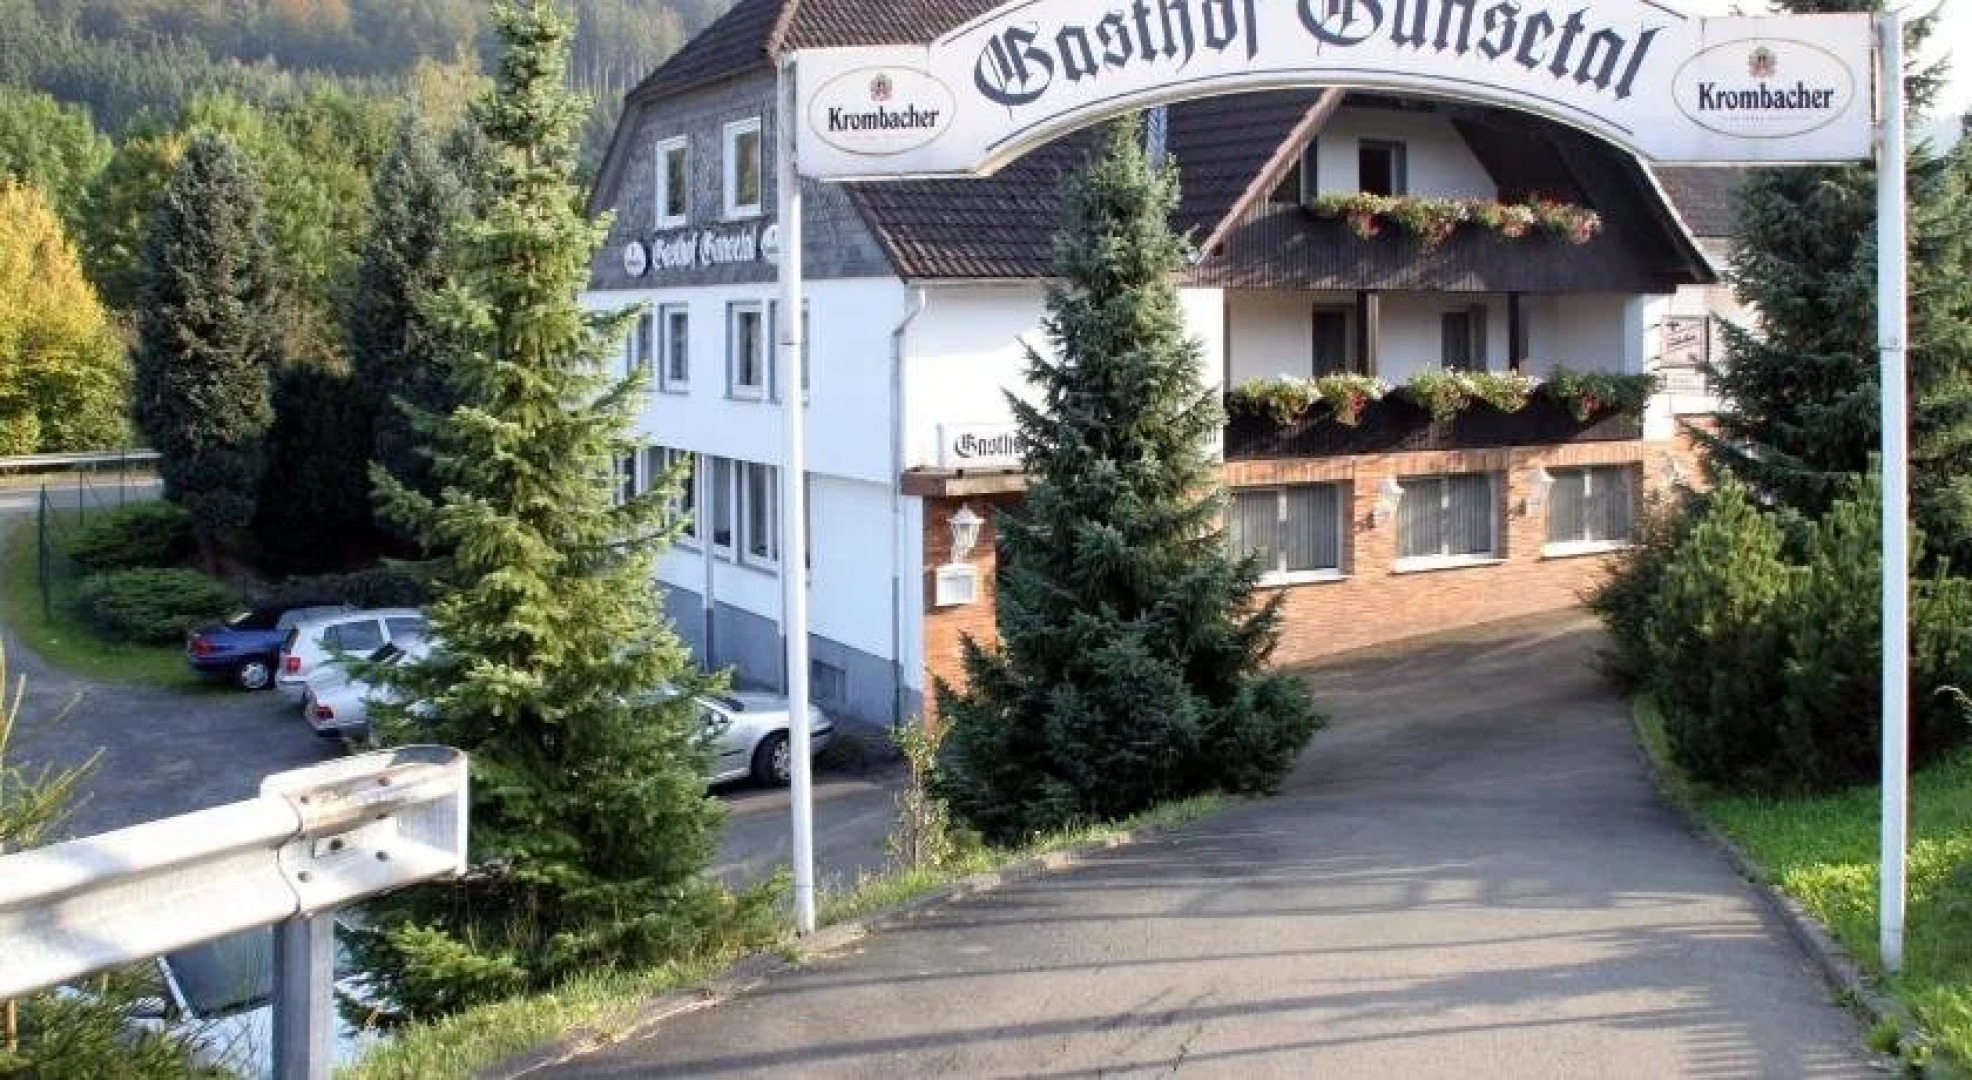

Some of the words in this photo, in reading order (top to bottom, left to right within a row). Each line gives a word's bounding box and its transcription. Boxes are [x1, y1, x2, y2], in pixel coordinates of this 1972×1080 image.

[974, 0, 1260, 118] Gasthof
[1698, 80, 1835, 110] Krombacher
[828, 102, 940, 132] Krombacher
